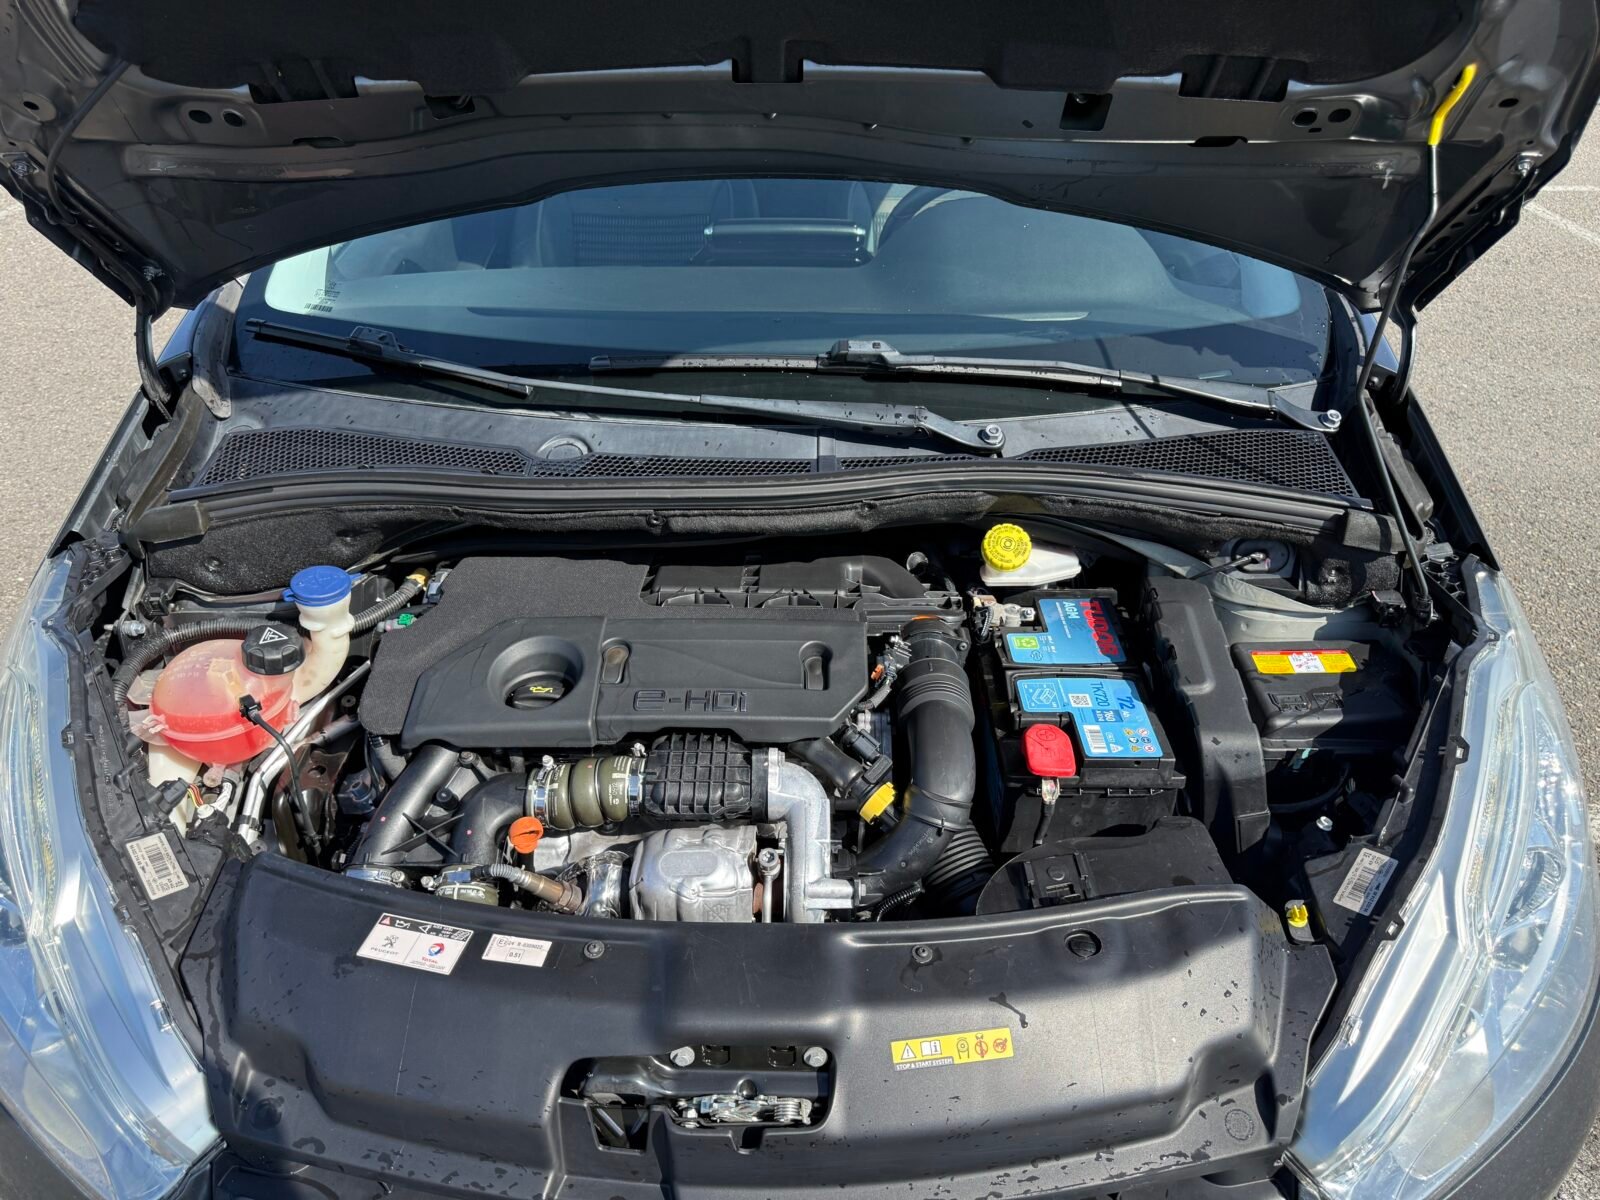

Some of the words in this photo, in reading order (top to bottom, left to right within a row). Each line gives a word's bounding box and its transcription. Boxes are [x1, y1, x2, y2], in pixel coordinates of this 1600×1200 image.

[1063, 601, 1080, 619] AGM
[1080, 600, 1119, 656] TUDOR
[1090, 681, 1110, 707] TK720
[1117, 696, 1136, 710] 72
[1103, 710, 1116, 722] 760
[370, 946, 400, 956] PEUGEOT
[508, 951, 522, 959] 0.51
[896, 1063, 911, 1071] STOP
[916, 1060, 932, 1068] START
[932, 1058, 953, 1066] SYSTEM
